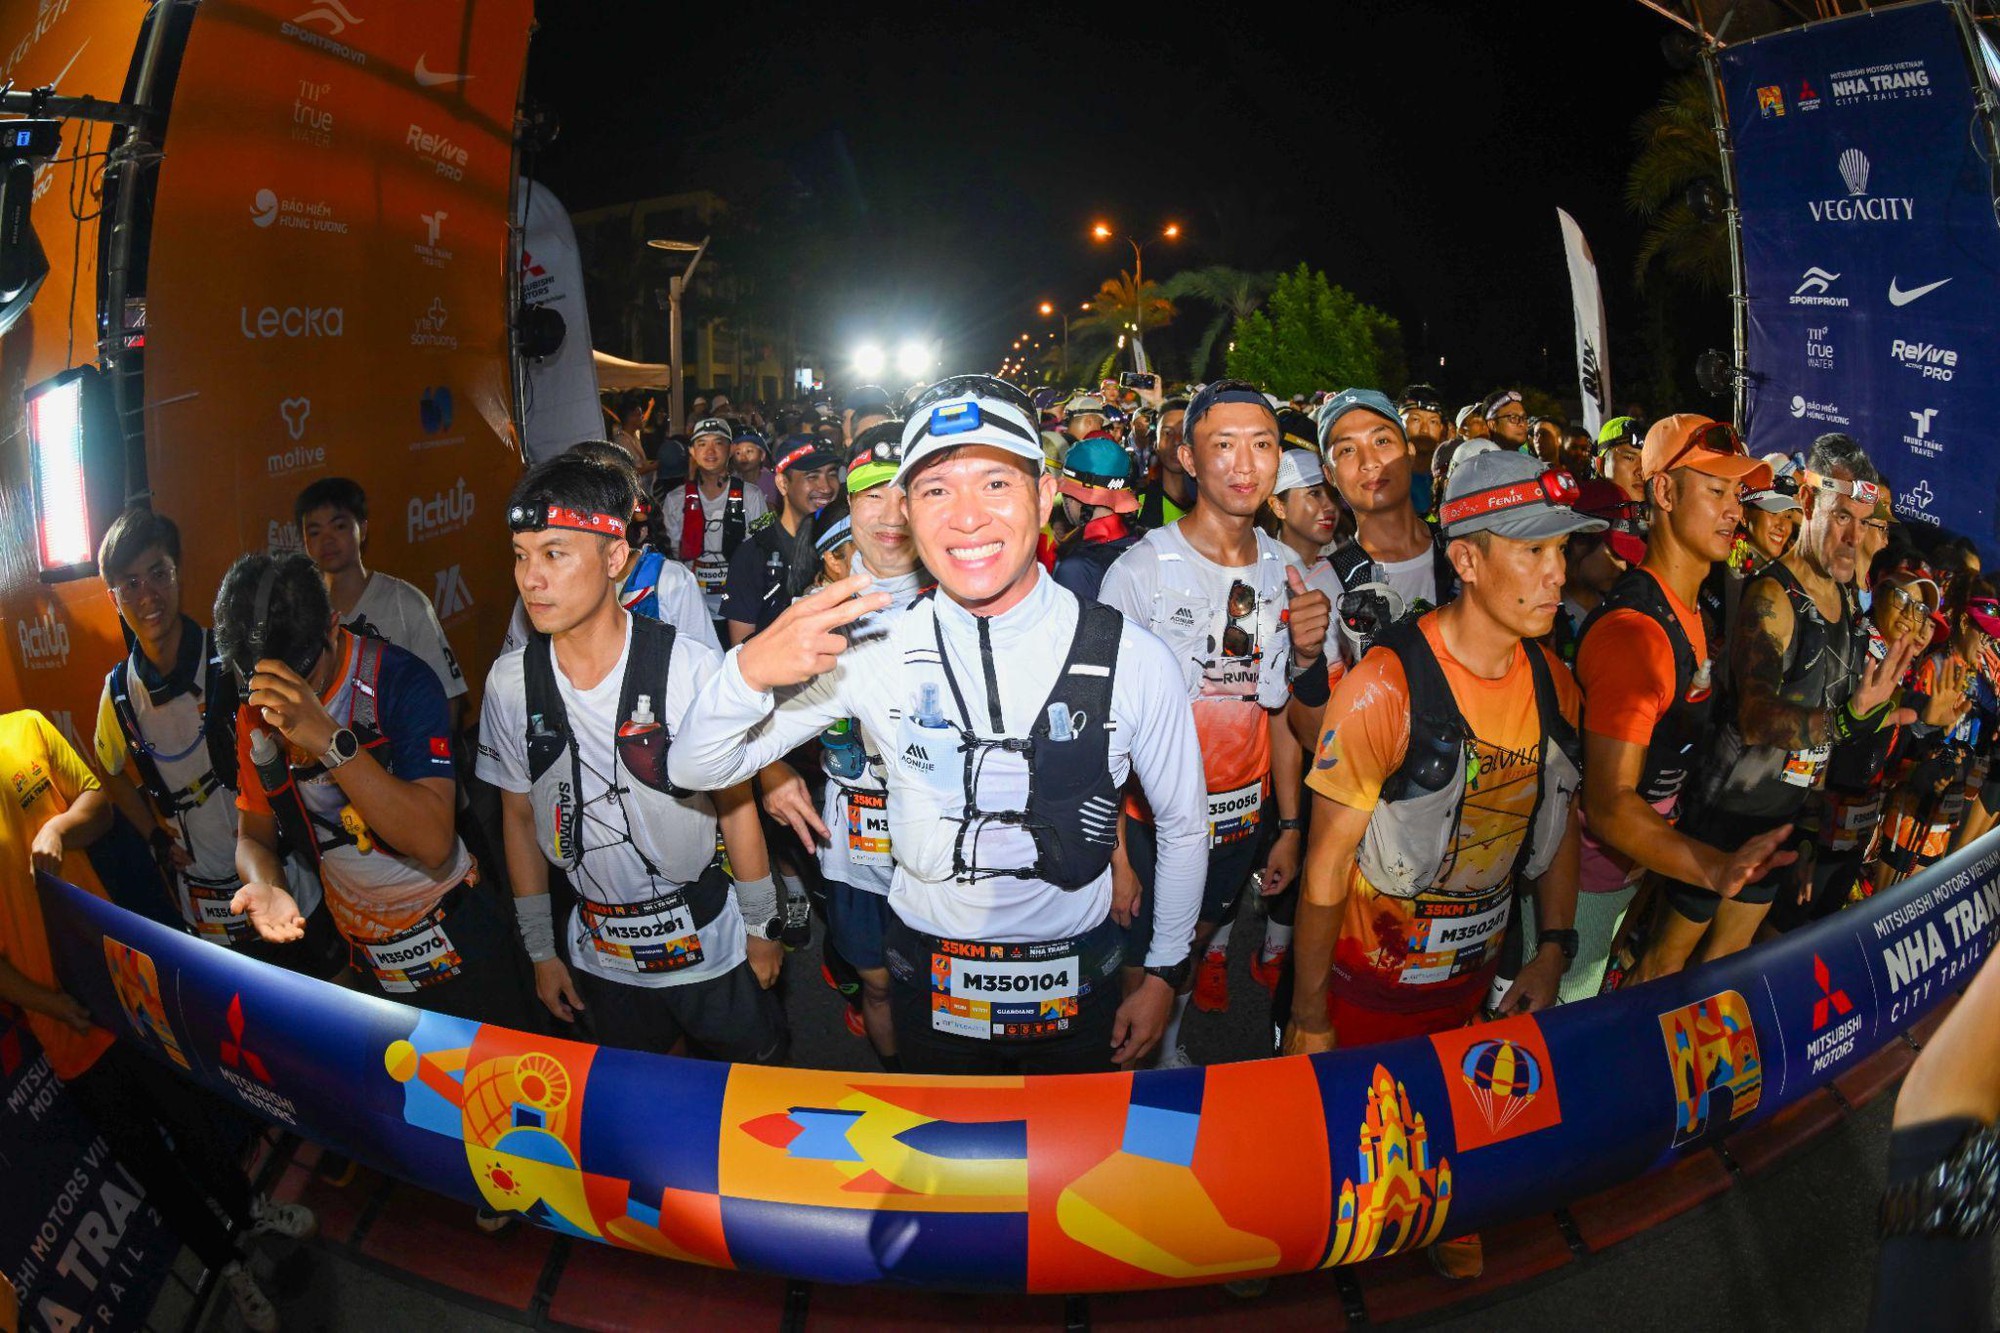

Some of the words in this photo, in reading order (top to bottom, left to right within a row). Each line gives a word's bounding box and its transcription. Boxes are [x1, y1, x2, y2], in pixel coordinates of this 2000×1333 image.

[1866, 64, 1893, 75] MOTORS
[1894, 60, 1924, 71] VIETNAM
[1832, 79, 1869, 97] NHA
[1870, 71, 1930, 92] TRANG
[1836, 97, 1860, 106] CITY
[1866, 92, 1899, 102] TRAIL
[293, 100, 333, 131] true
[435, 162, 462, 181] PRO
[1808, 198, 1914, 222] VEGACITY
[1807, 340, 1834, 358] true
[1807, 357, 1834, 370] WATER
[1922, 365, 1953, 381] PRO
[1903, 435, 1923, 446] TRUNG
[1910, 445, 1935, 459] TRAVEL
[267, 446, 326, 473] motive
[1895, 503, 1940, 528] sonhuong
[901, 753, 935, 773] AONIJIE
[853, 793, 883, 808] 35KM
[558, 781, 575, 860] SALOMON
[1423, 904, 1466, 915] 35KM
[1873, 892, 1935, 940] MITSUBISHI
[1932, 871, 1970, 905] MOTORS
[376, 936, 444, 964] M350070
[941, 940, 986, 959] 35KM
[1882, 921, 1948, 995] NHA
[963, 970, 1070, 992] M350104
[1891, 979, 1932, 1023] CITY
[1941, 942, 1980, 986] TRAIL
[996, 1008, 1035, 1016] GUARDIANS
[1806, 1013, 1862, 1060] MITSUBISHI
[1812, 1038, 1855, 1076] MOTORS
[218, 1066, 298, 1115] MITSUBISHI
[237, 1087, 298, 1126] MOTORS
[30, 1166, 90, 1263] MOTORS
